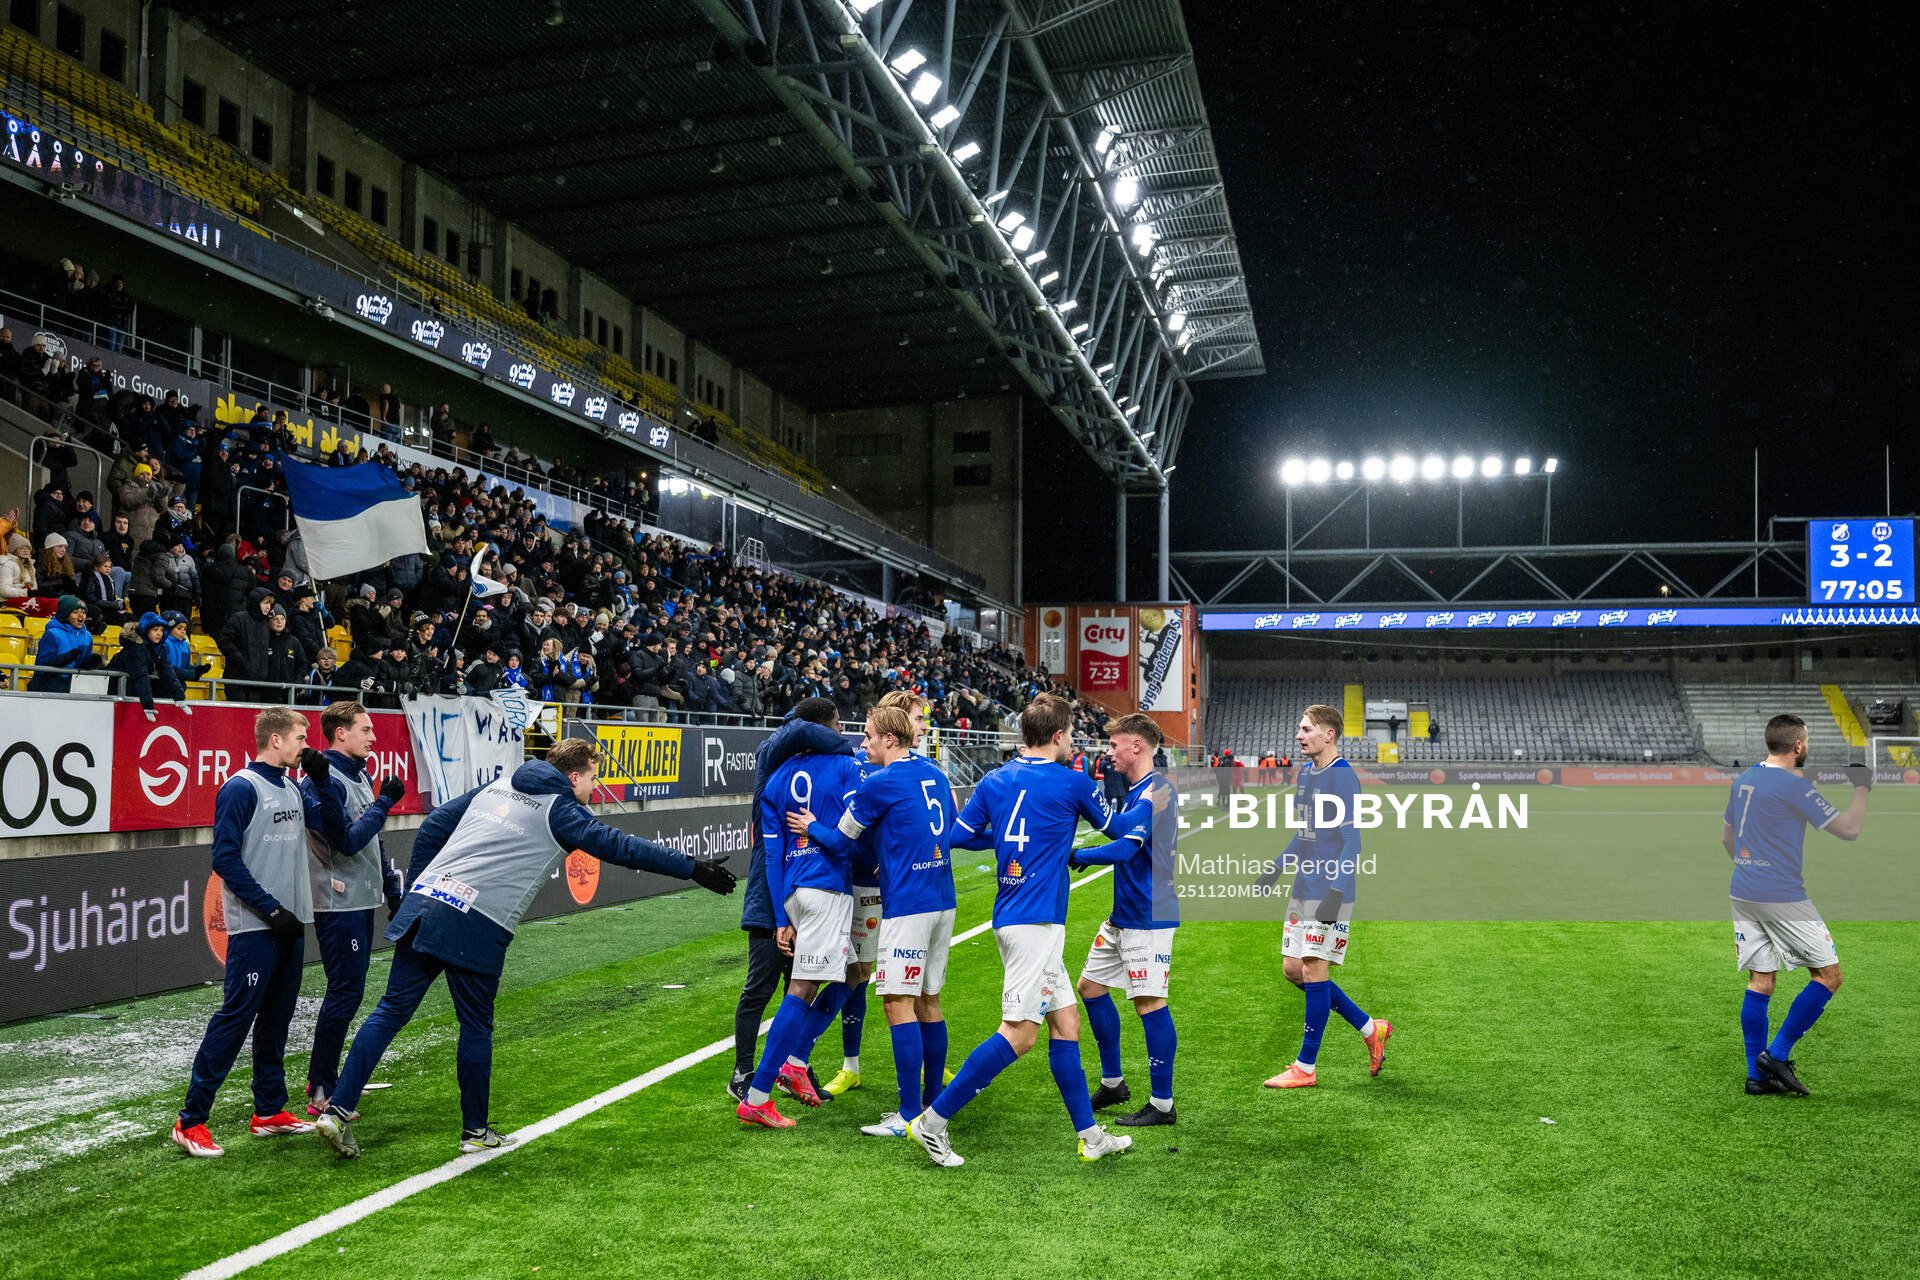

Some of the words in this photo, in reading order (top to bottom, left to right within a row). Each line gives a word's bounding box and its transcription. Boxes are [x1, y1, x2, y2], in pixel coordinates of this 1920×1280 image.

[1830, 544, 1850, 568] 3
[1873, 543, 1893, 567] 2
[1820, 579, 1903, 600] 77:05
[1089, 668, 1120, 679] 7-23
[598, 730, 678, 779] BLÅKLÄDER
[790, 770, 813, 811] 9
[1459, 771, 1501, 781] Sparbanken
[920, 779, 945, 836] 5
[1004, 789, 1030, 852] 4
[1738, 784, 1755, 837] 7
[703, 821, 749, 859] Sjuhärad
[8, 880, 189, 971] Sjuhärad
[351, 938, 359, 951] 8
[246, 972, 259, 986] 19
